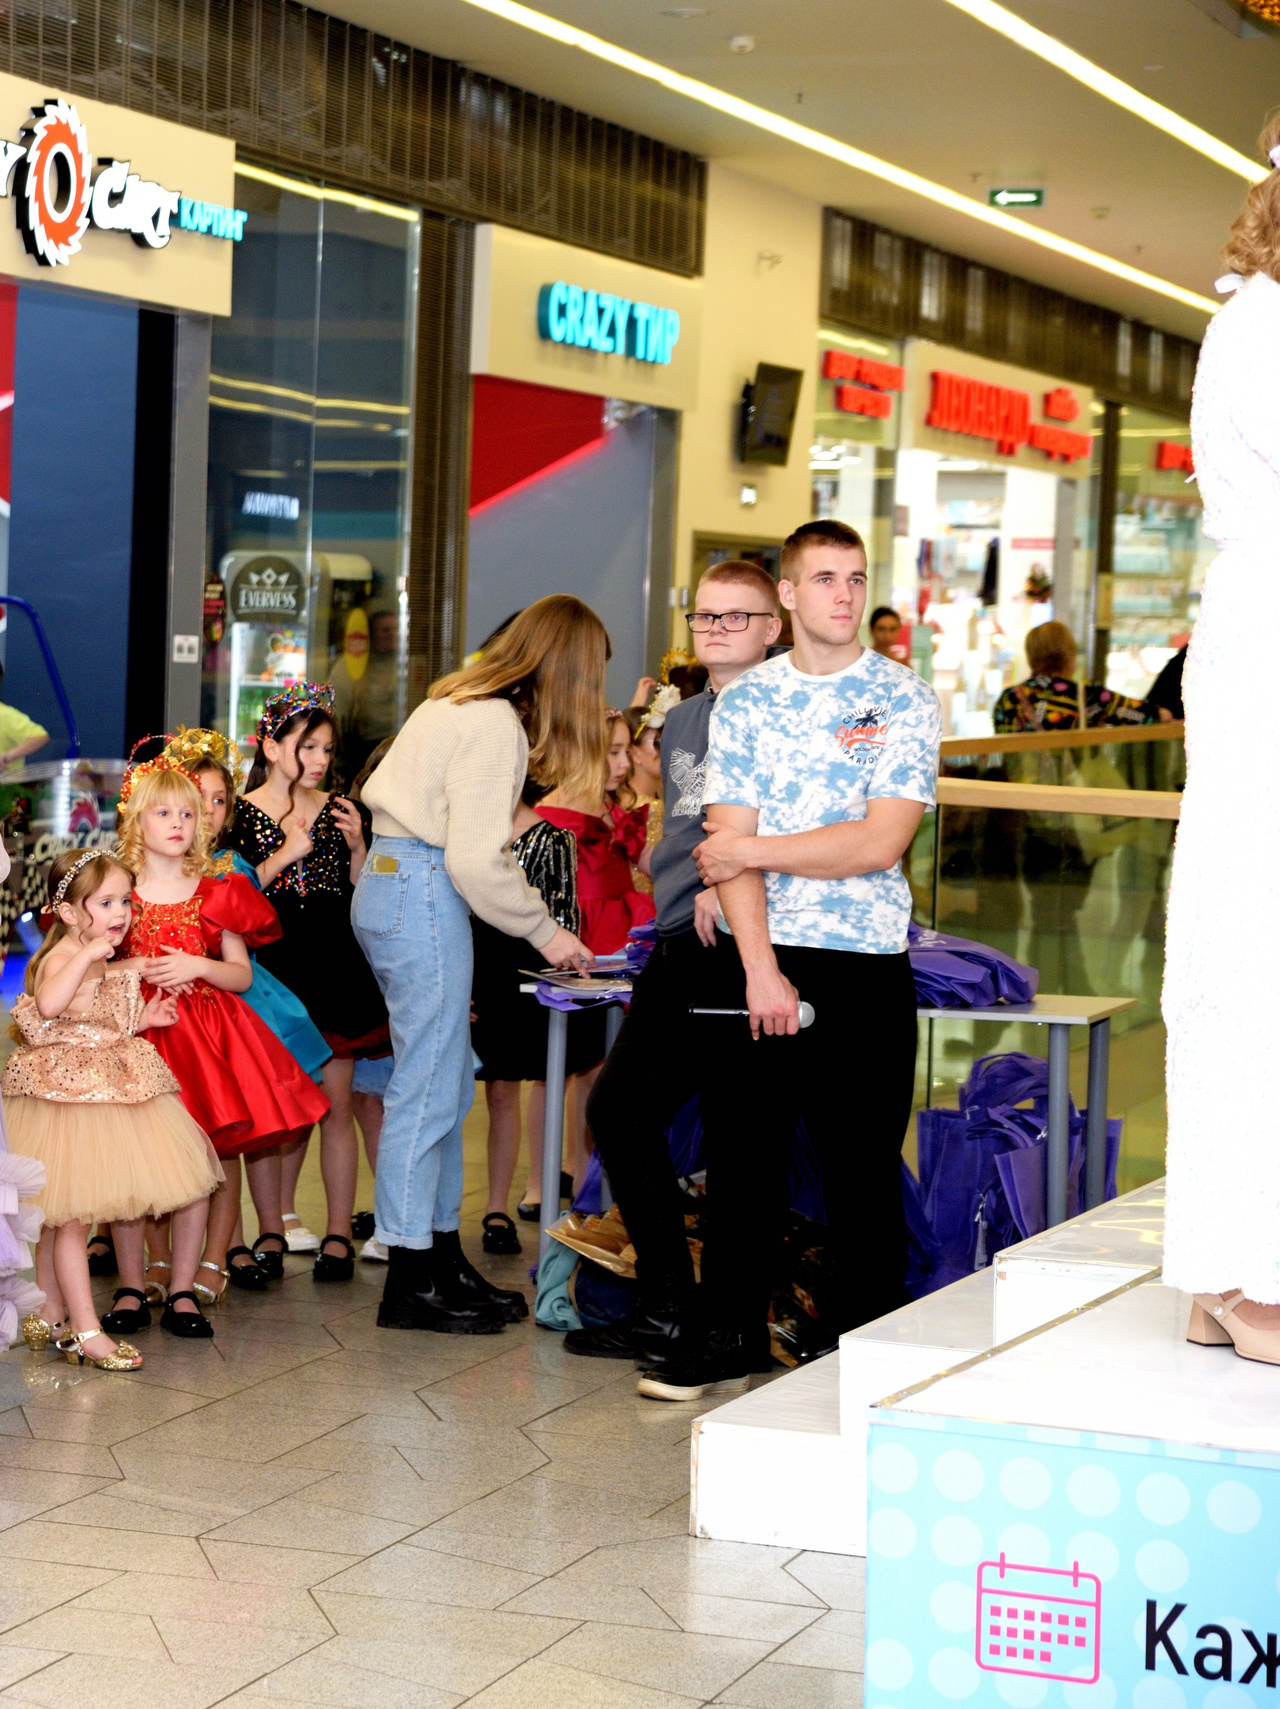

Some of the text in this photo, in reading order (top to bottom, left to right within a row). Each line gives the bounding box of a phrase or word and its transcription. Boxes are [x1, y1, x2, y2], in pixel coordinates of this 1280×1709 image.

[179, 196, 249, 242] КАРТИНГ
[548, 280, 680, 365] CRAZY ТИР
[239, 588, 297, 609] EVERVESS
